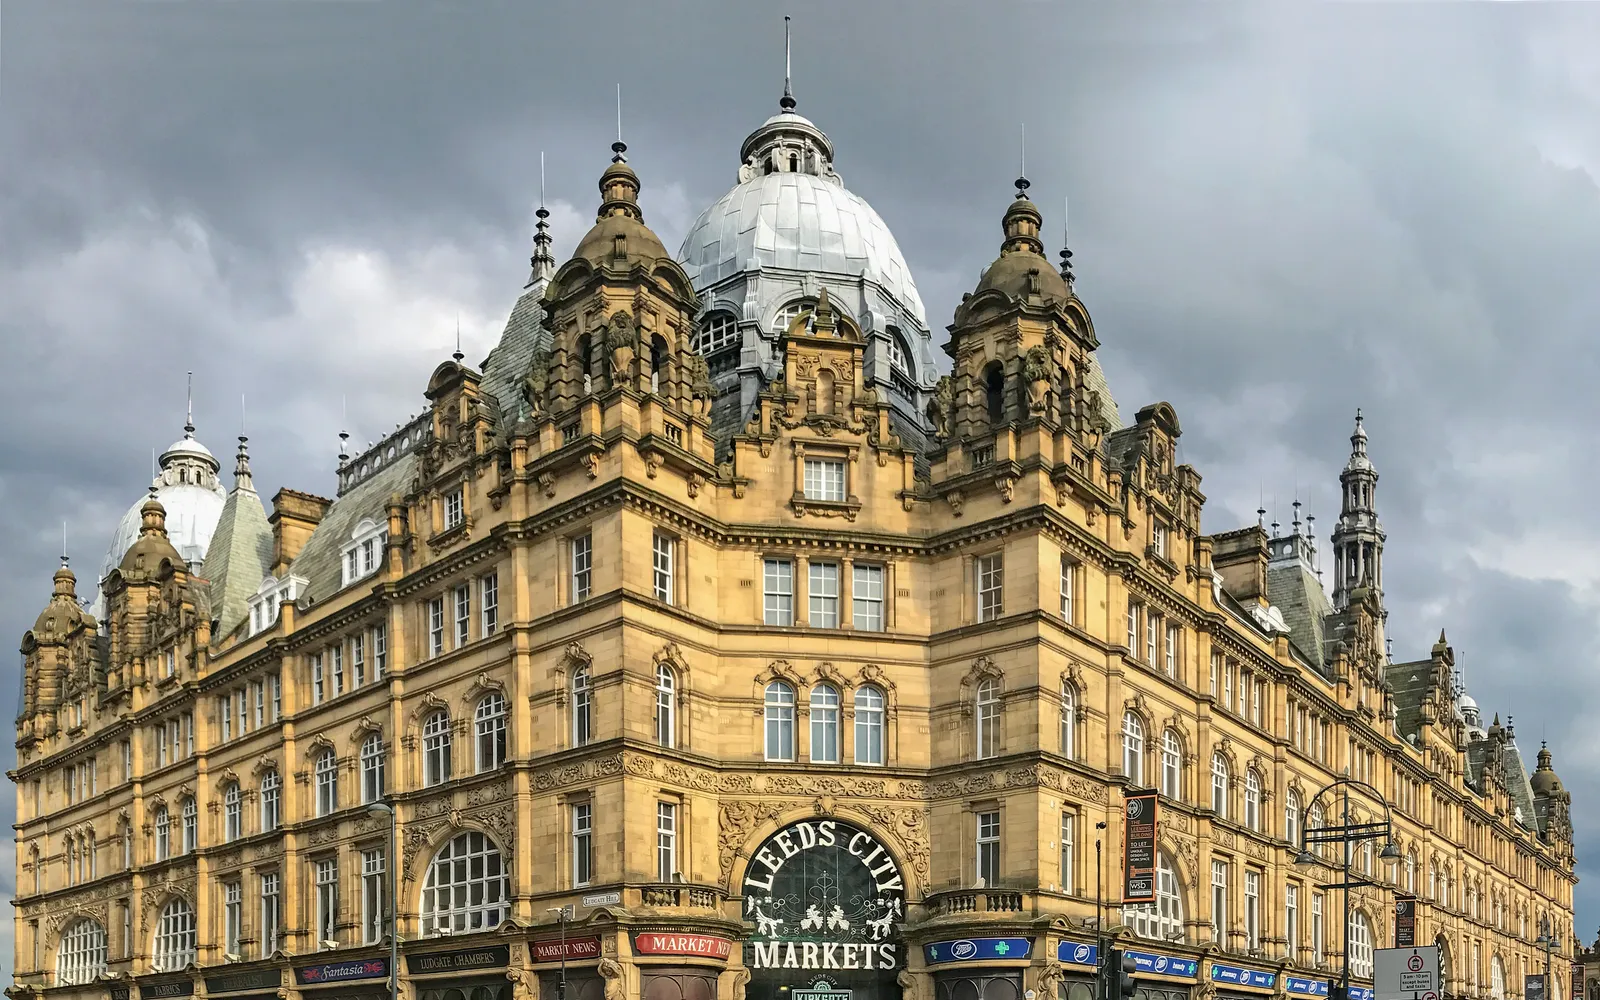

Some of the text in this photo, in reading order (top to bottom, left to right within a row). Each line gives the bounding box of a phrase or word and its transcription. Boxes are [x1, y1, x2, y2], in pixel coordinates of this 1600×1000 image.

[745, 820, 903, 893] LEEDS CITY
[1131, 880, 1146, 889] wsb
[537, 941, 597, 957] MARKET NEWS
[652, 936, 714, 953] MARKET
[420, 952, 495, 970] LUDGATE CHAMBERS
[753, 941, 896, 970] MARKETS
[320, 964, 364, 981] Fantasia
[807, 974, 838, 986] LEEDS CITY
[1220, 970, 1237, 980] pharmacy
[154, 984, 180, 996] FABRICS
